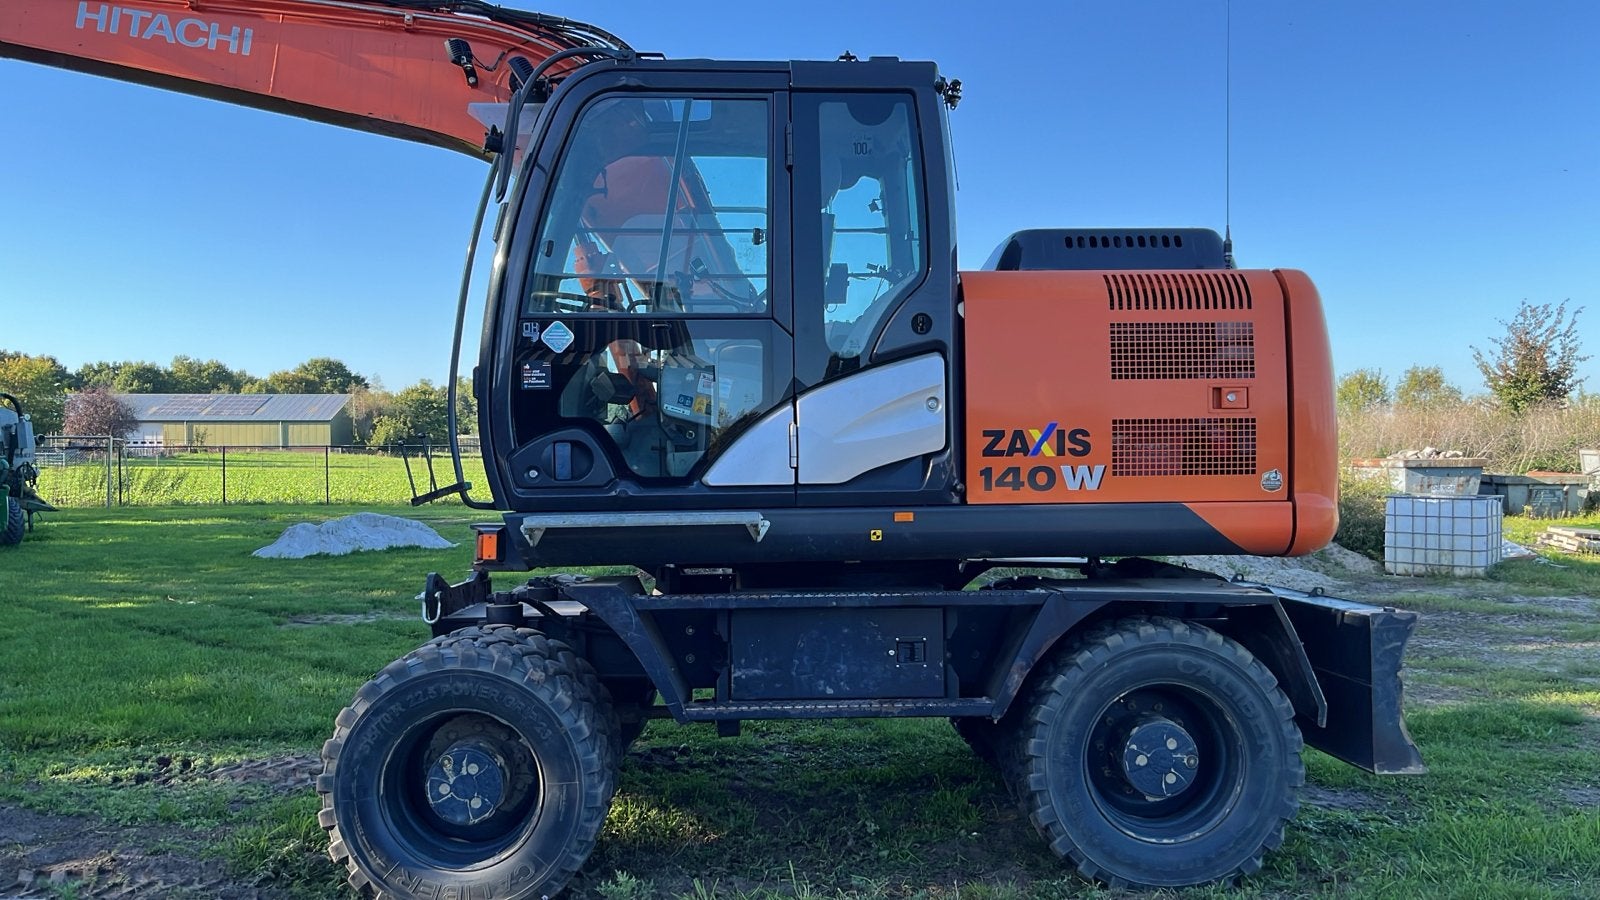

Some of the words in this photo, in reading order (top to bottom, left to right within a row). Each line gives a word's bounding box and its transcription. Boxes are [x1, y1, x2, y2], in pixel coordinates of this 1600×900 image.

[75, 1, 254, 56] HITACHI
[982, 421, 1092, 457] ZAXIS
[440, 682, 499, 702] POWER
